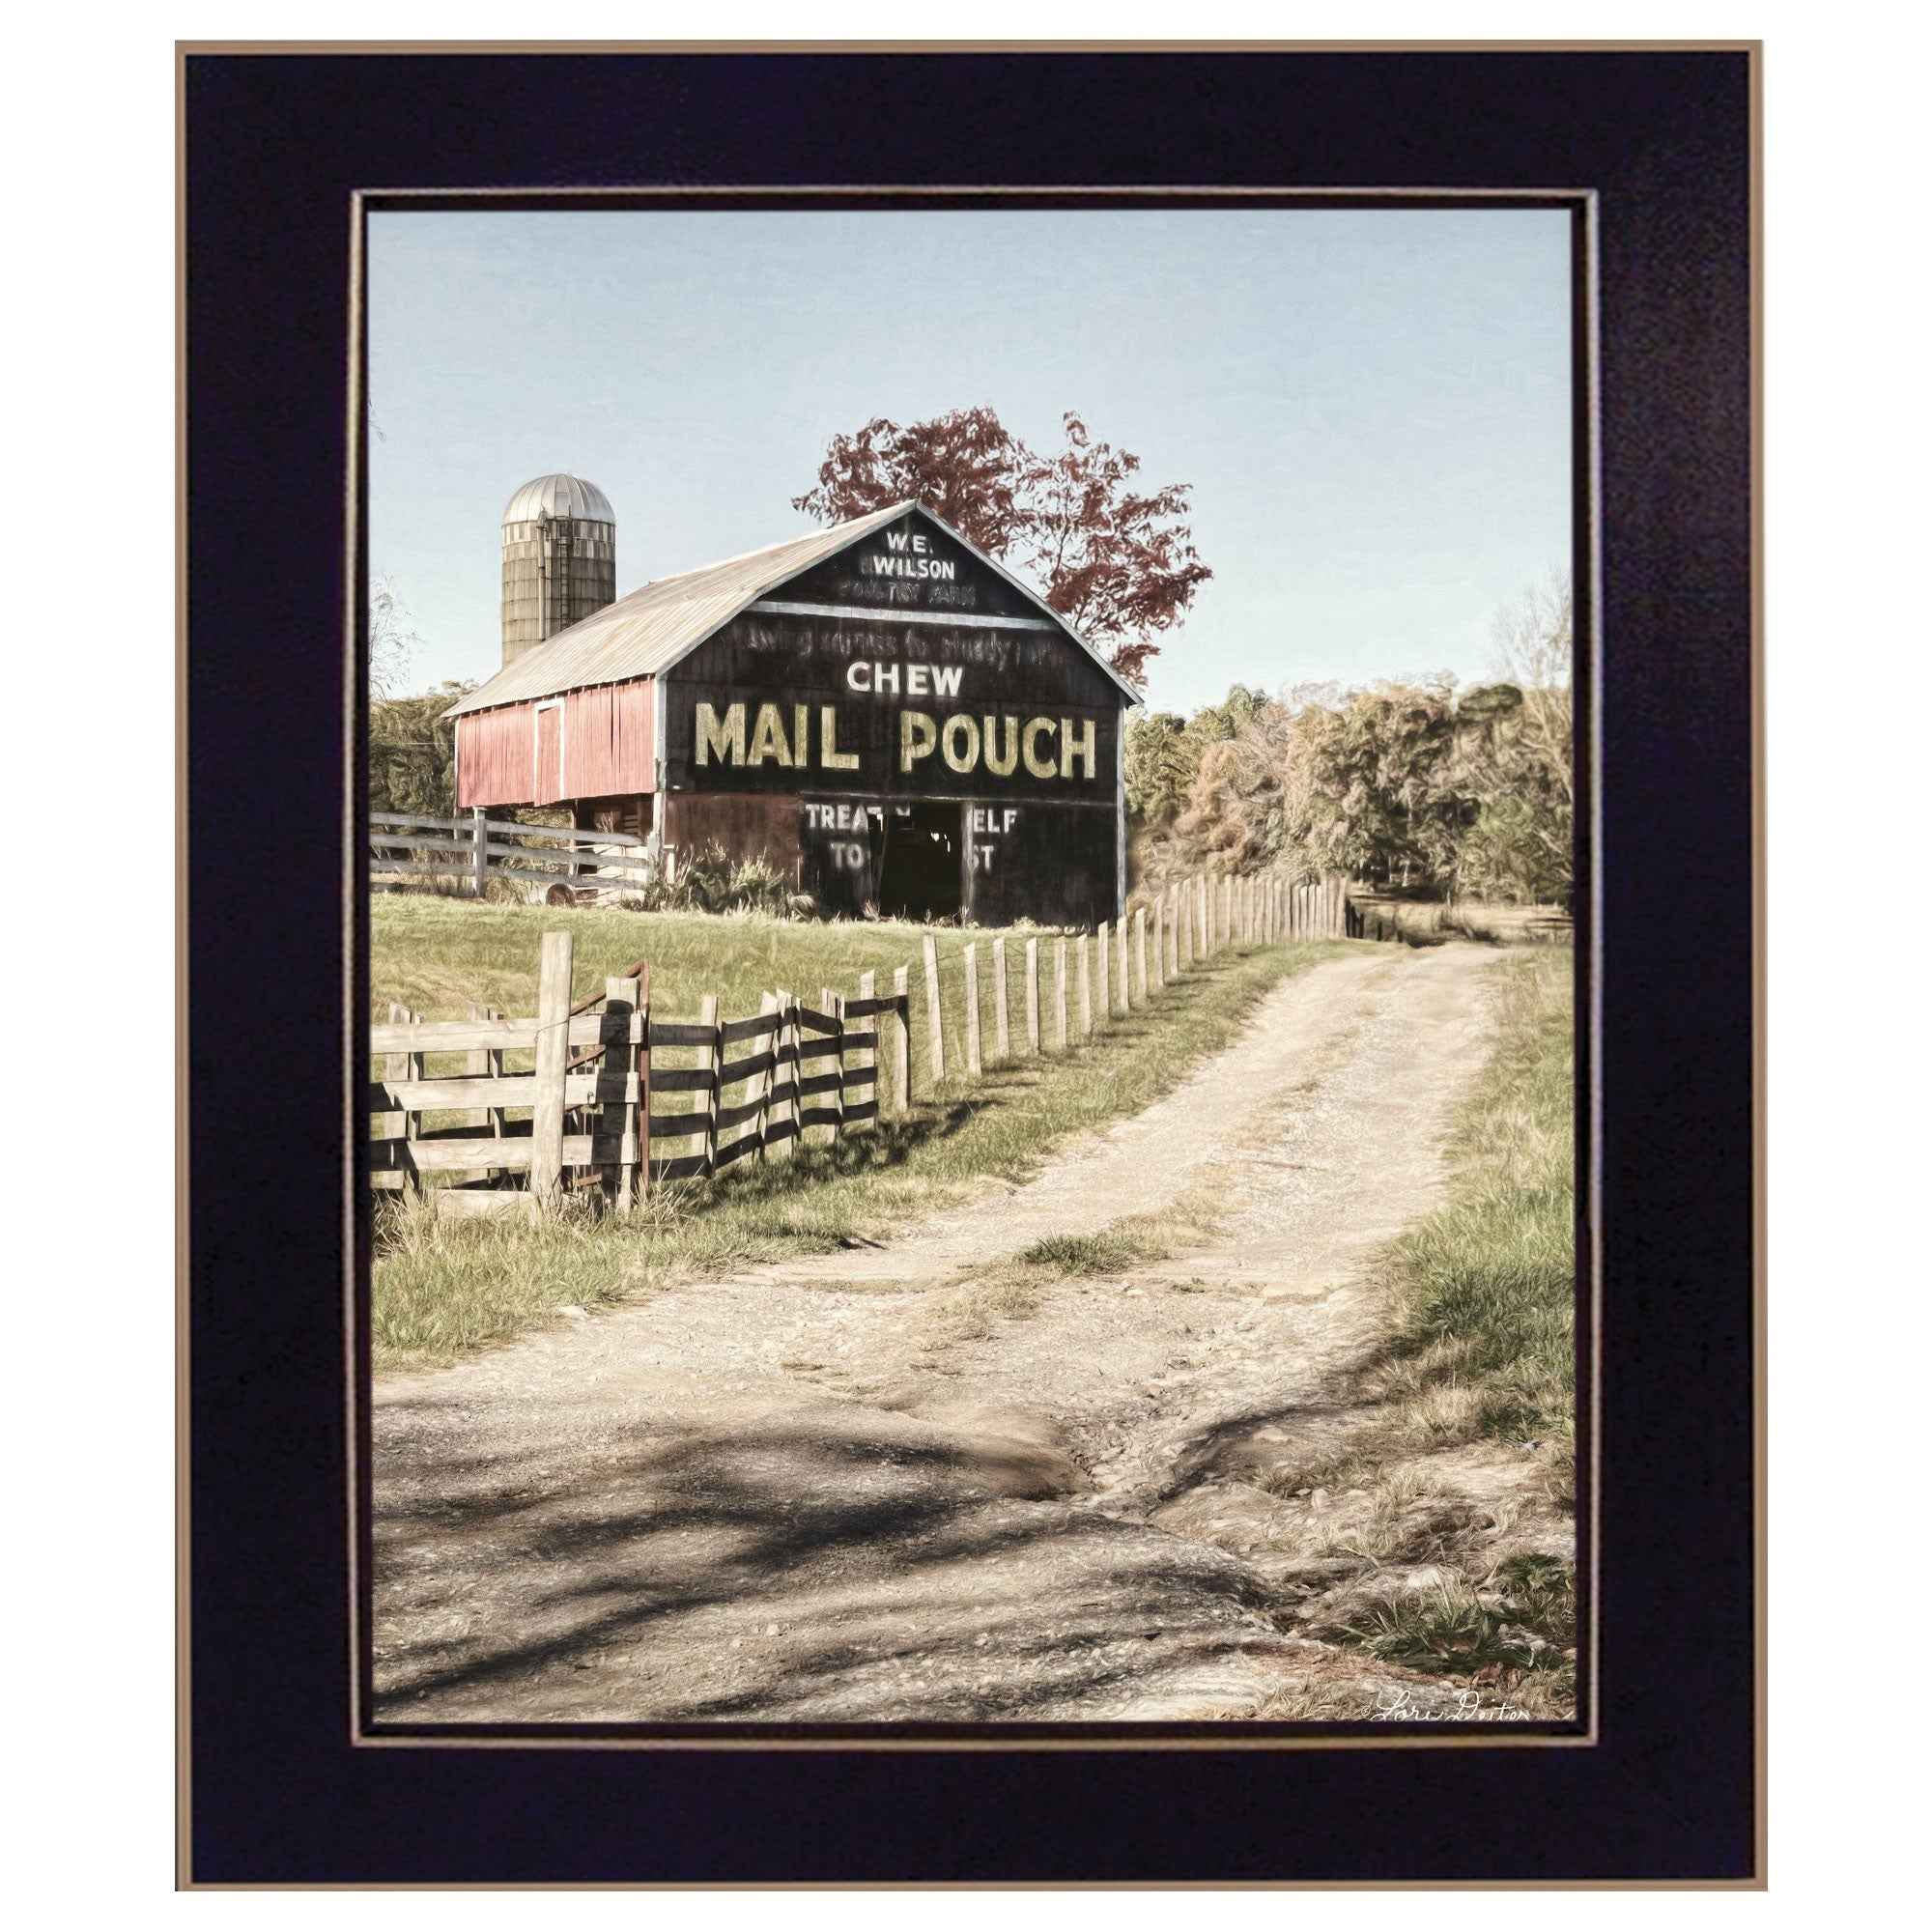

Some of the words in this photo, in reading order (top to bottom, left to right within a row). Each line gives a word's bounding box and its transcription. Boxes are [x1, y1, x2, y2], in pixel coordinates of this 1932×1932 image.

[873, 555, 954, 580] WILSON
[846, 662, 963, 696] CHEW
[696, 702, 860, 769] MAIL
[899, 710, 1096, 780] POUCH
[831, 842, 866, 869] TO
